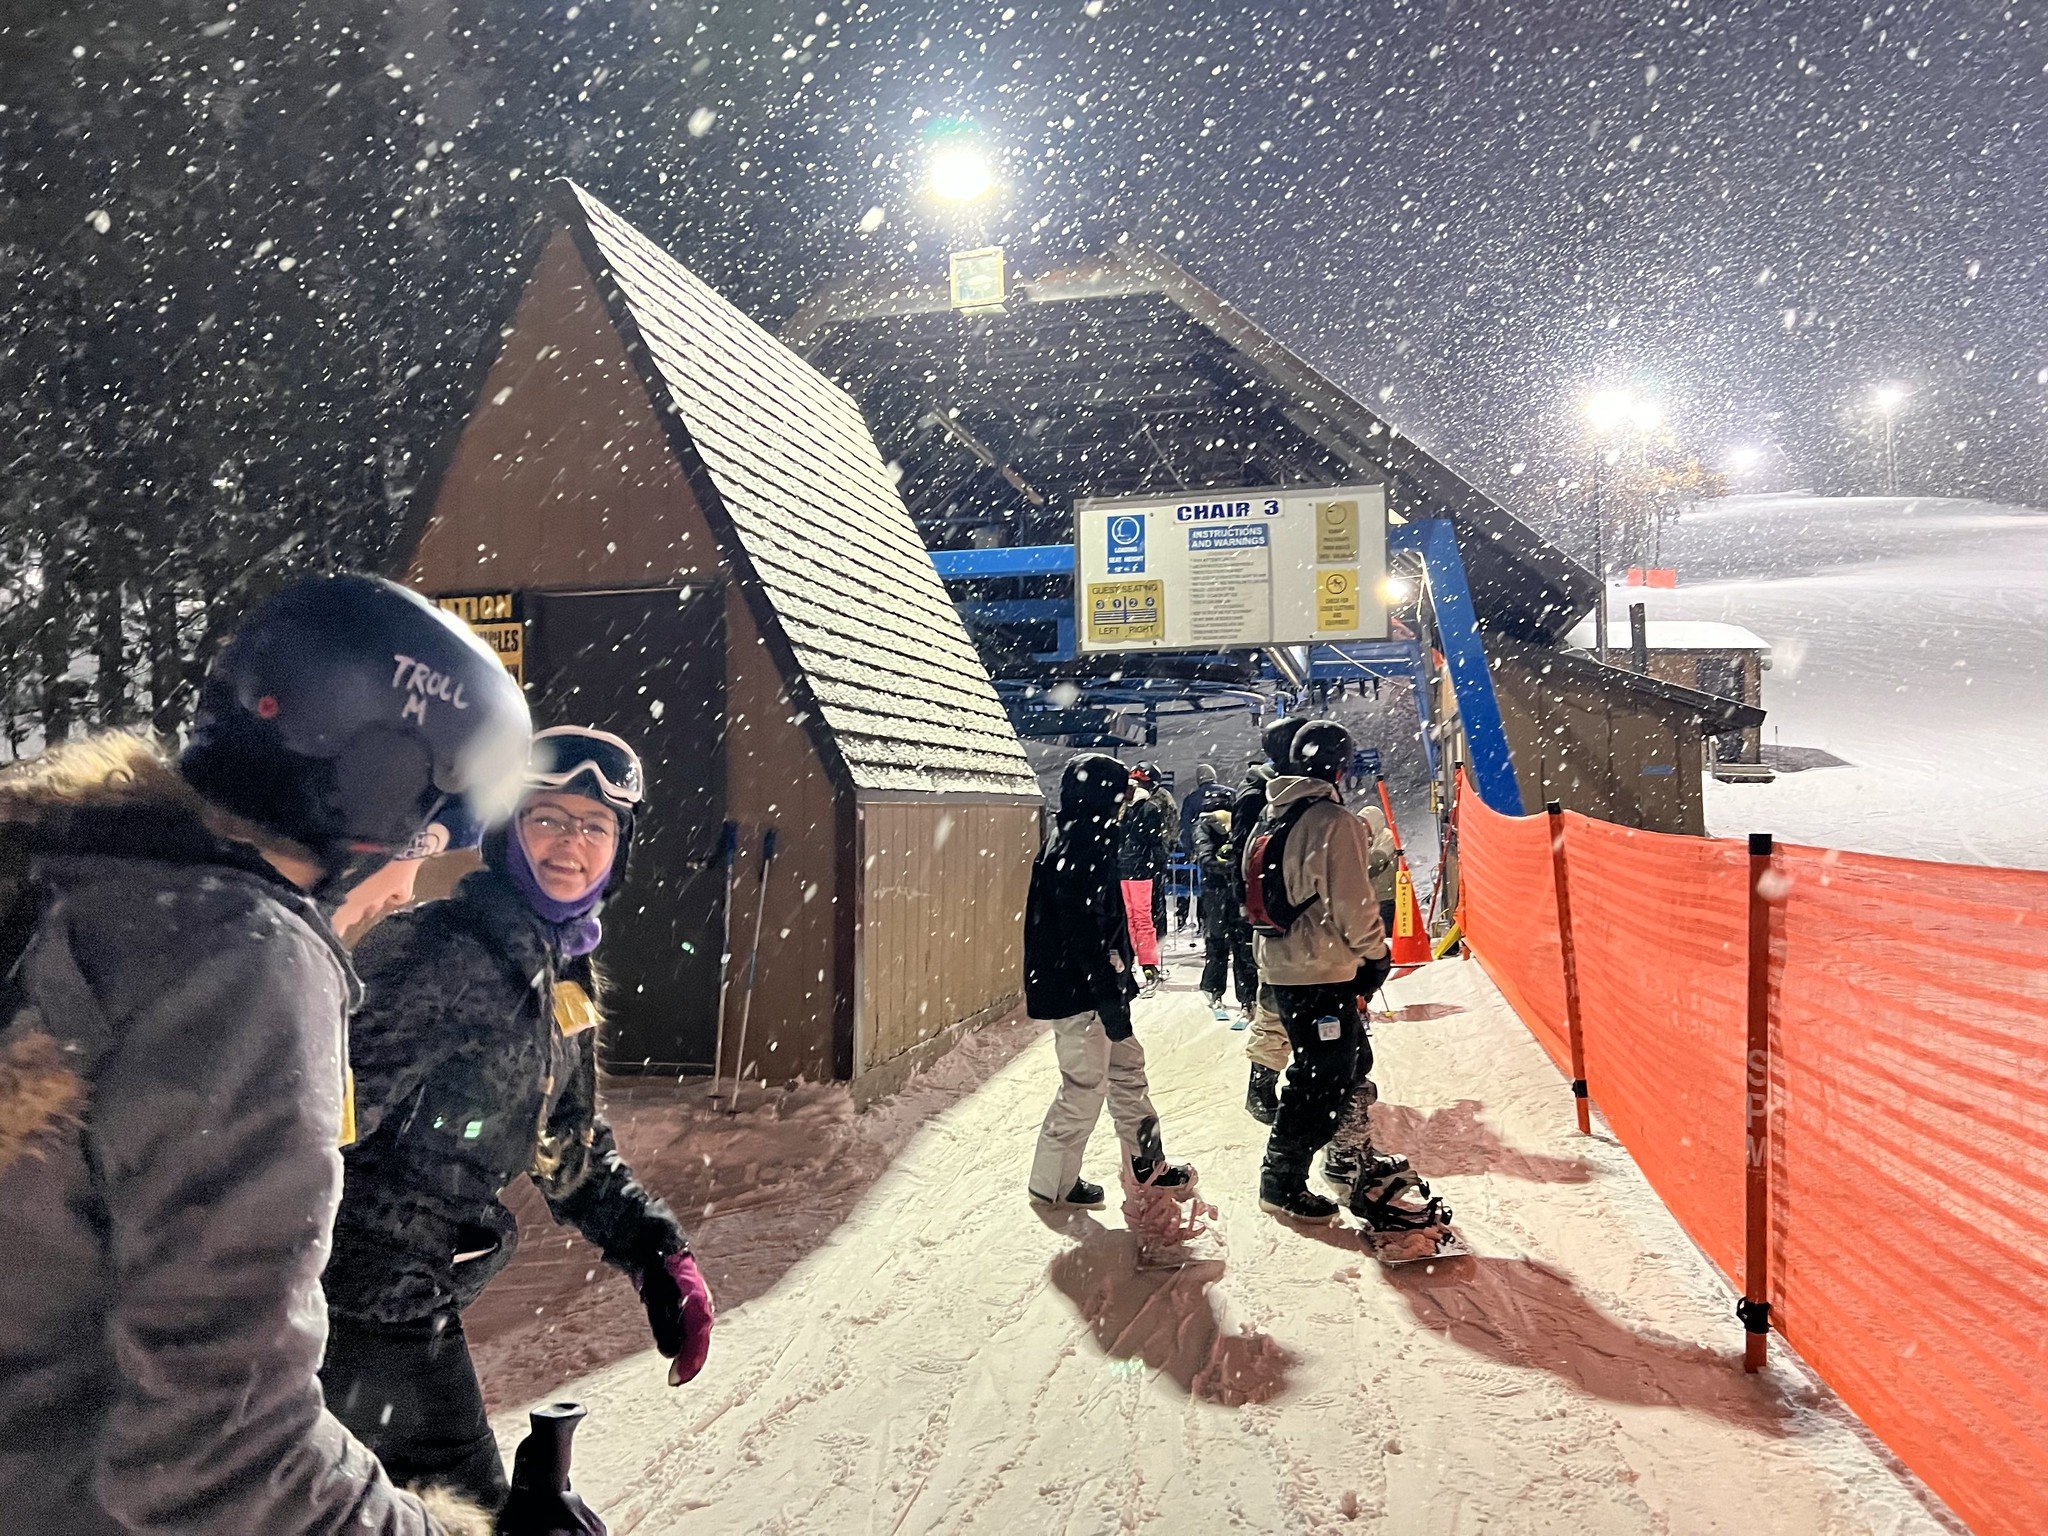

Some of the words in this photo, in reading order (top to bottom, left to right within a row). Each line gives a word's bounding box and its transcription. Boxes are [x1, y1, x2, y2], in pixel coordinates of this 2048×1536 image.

[1177, 502, 1250, 521] CHAIR
[1264, 500, 1279, 515] 3
[1192, 526, 1263, 539] INSTRUCTIONS
[1191, 540, 1213, 549] AND
[1213, 536, 1266, 548] WARNINGS
[1092, 585, 1121, 594] GUEST
[1098, 626, 1120, 635] LEFT
[1129, 624, 1154, 634] RIGHT
[392, 654, 469, 710] TROLL
